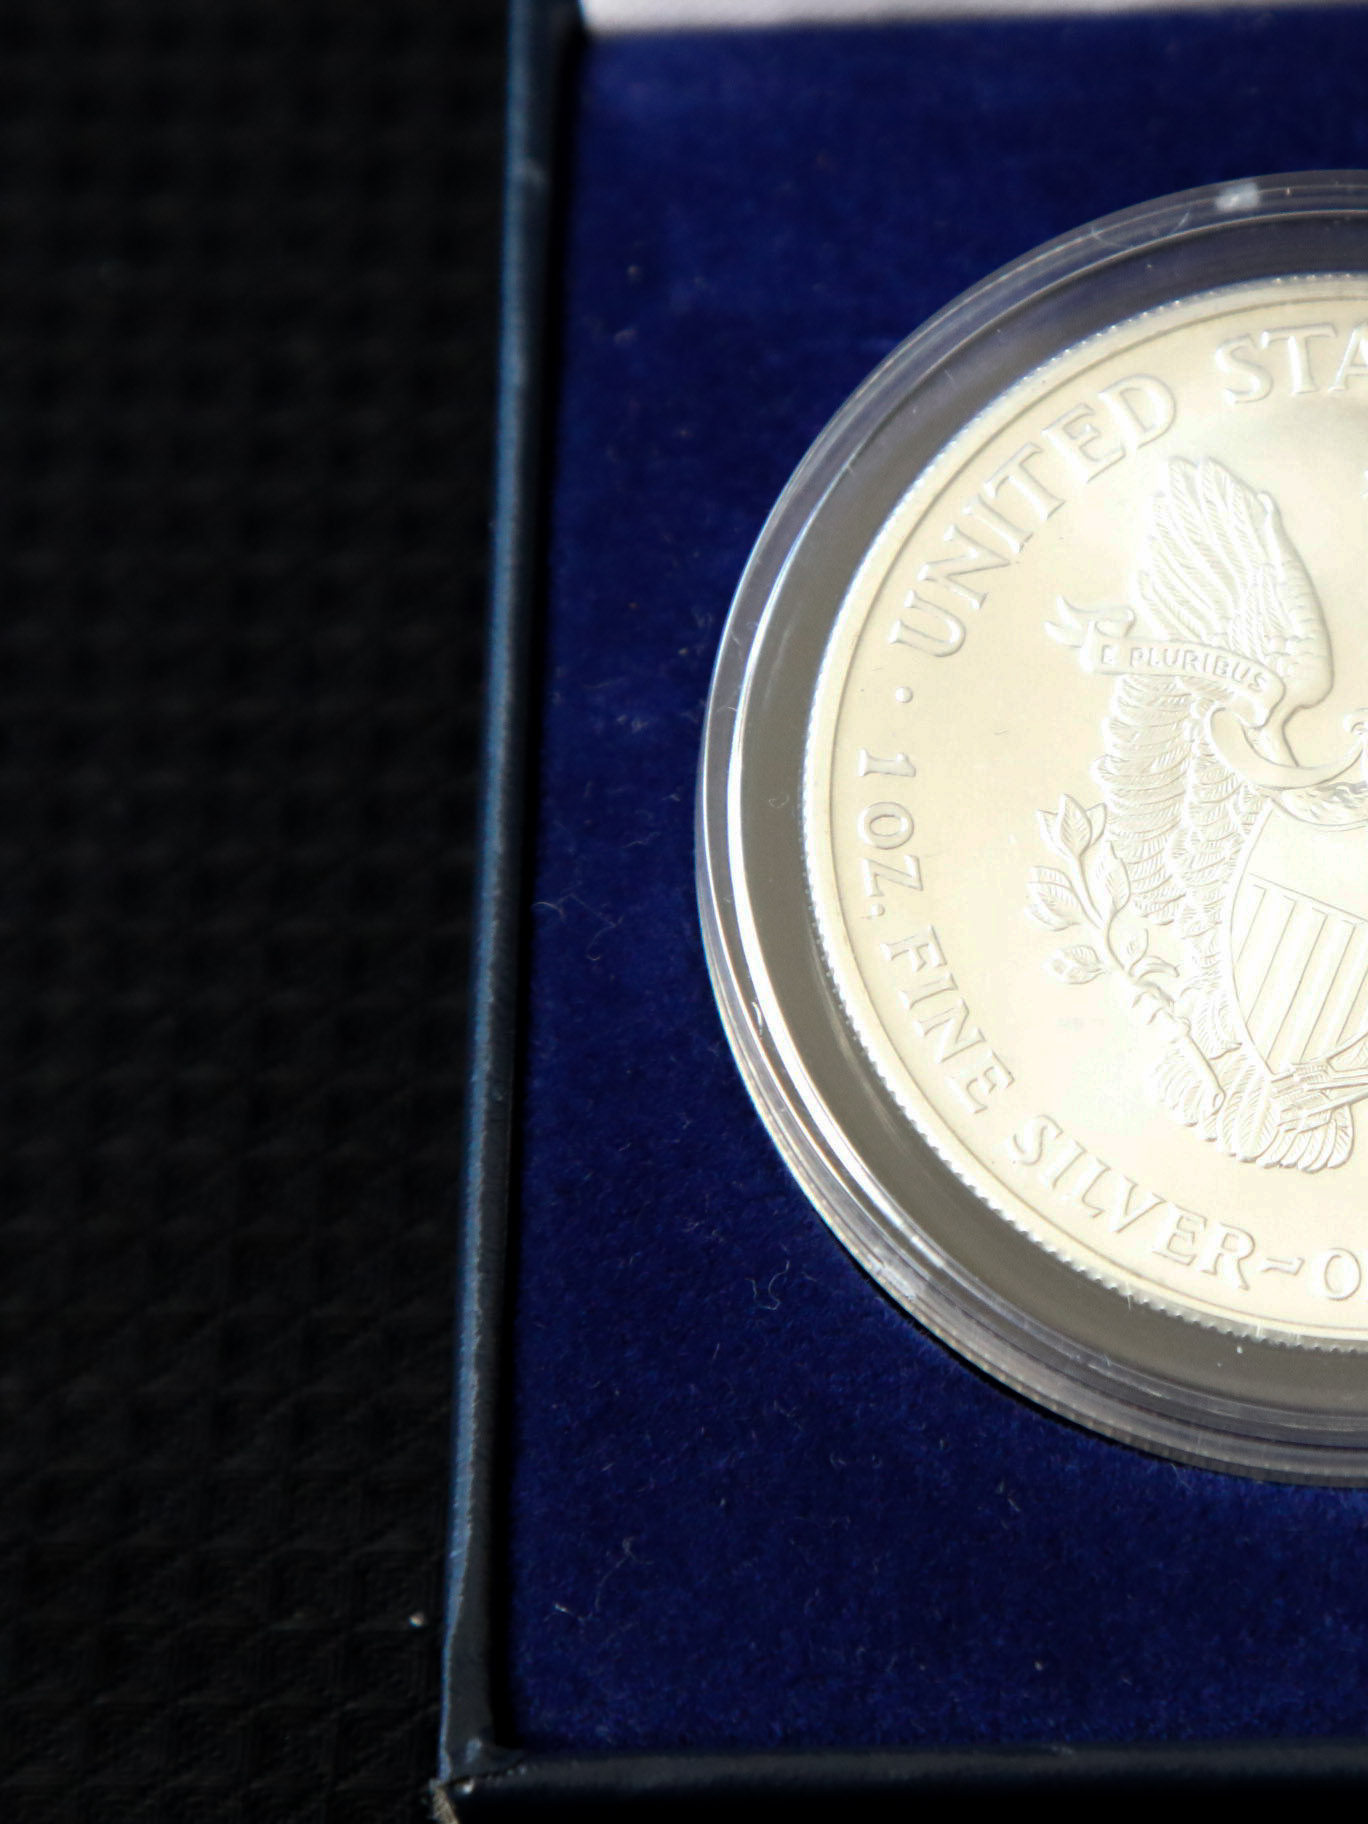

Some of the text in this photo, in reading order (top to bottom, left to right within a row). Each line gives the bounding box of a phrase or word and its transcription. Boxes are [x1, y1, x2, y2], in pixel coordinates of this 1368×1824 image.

[888, 372, 1178, 657] UNITED
[1129, 645, 1268, 693] PLURIBUS
[856, 747, 917, 779] 1
[880, 923, 1016, 1114] FINE
